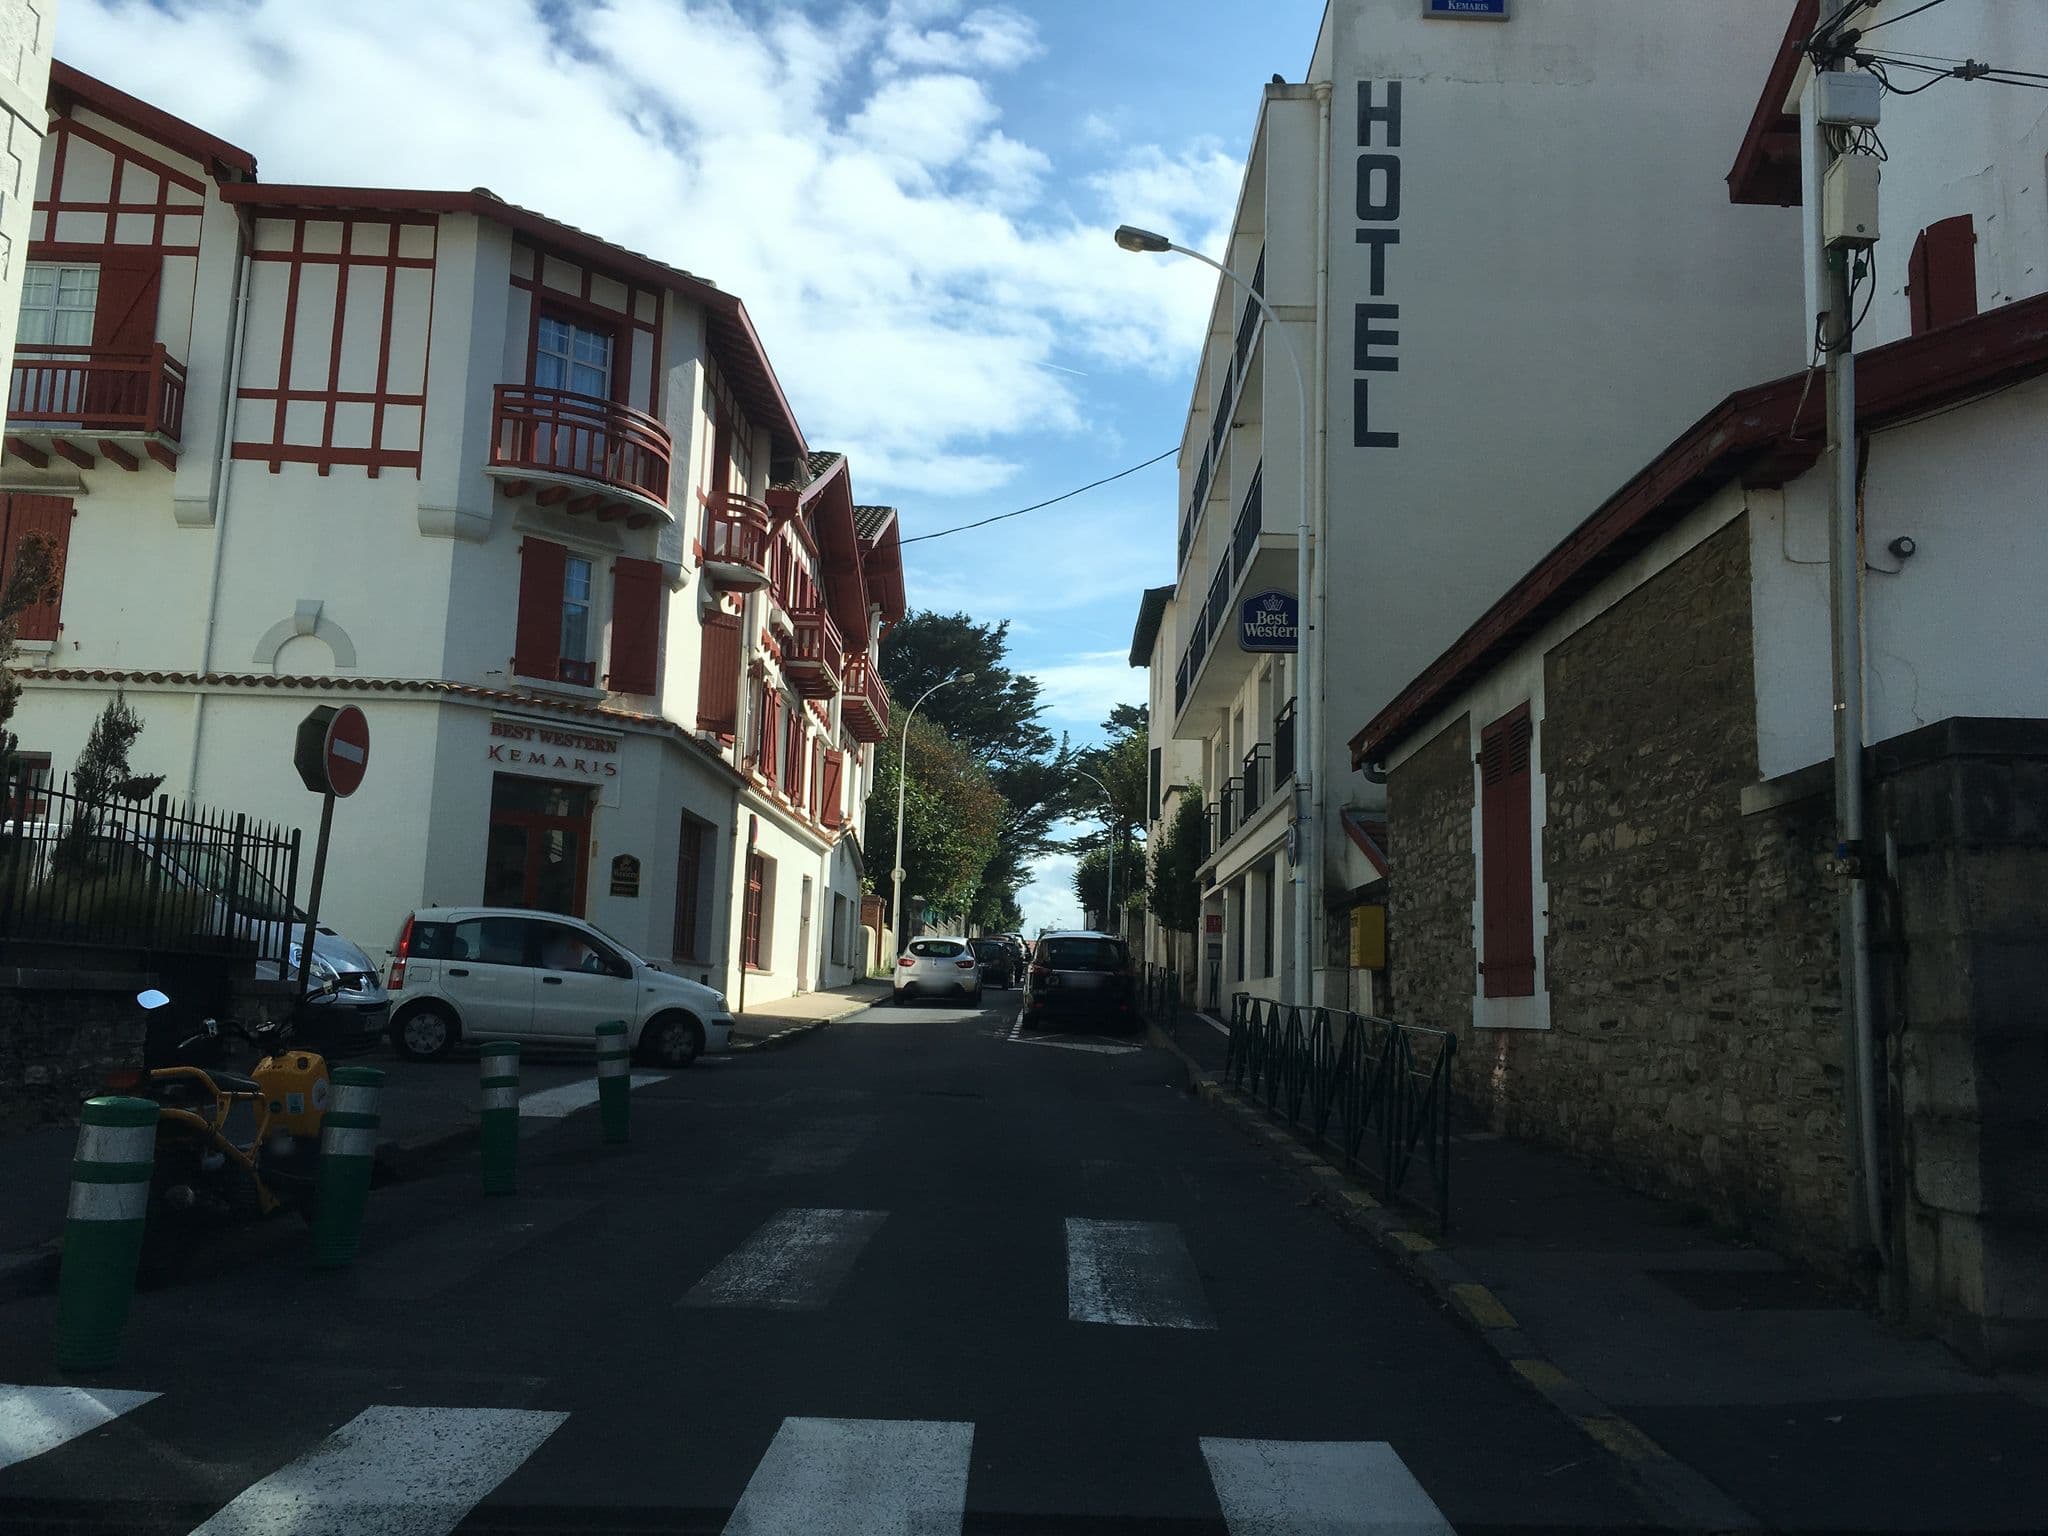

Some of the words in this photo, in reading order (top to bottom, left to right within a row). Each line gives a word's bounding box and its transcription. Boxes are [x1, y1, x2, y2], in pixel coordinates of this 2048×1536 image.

[1448, 0, 1489, 11] KEMARIS
[1354, 80, 1402, 448] HOTEL
[1256, 611, 1288, 625] Best
[491, 722, 535, 741] BEST
[539, 730, 617, 753] WESTERN
[488, 744, 617, 776] KEMARIS
